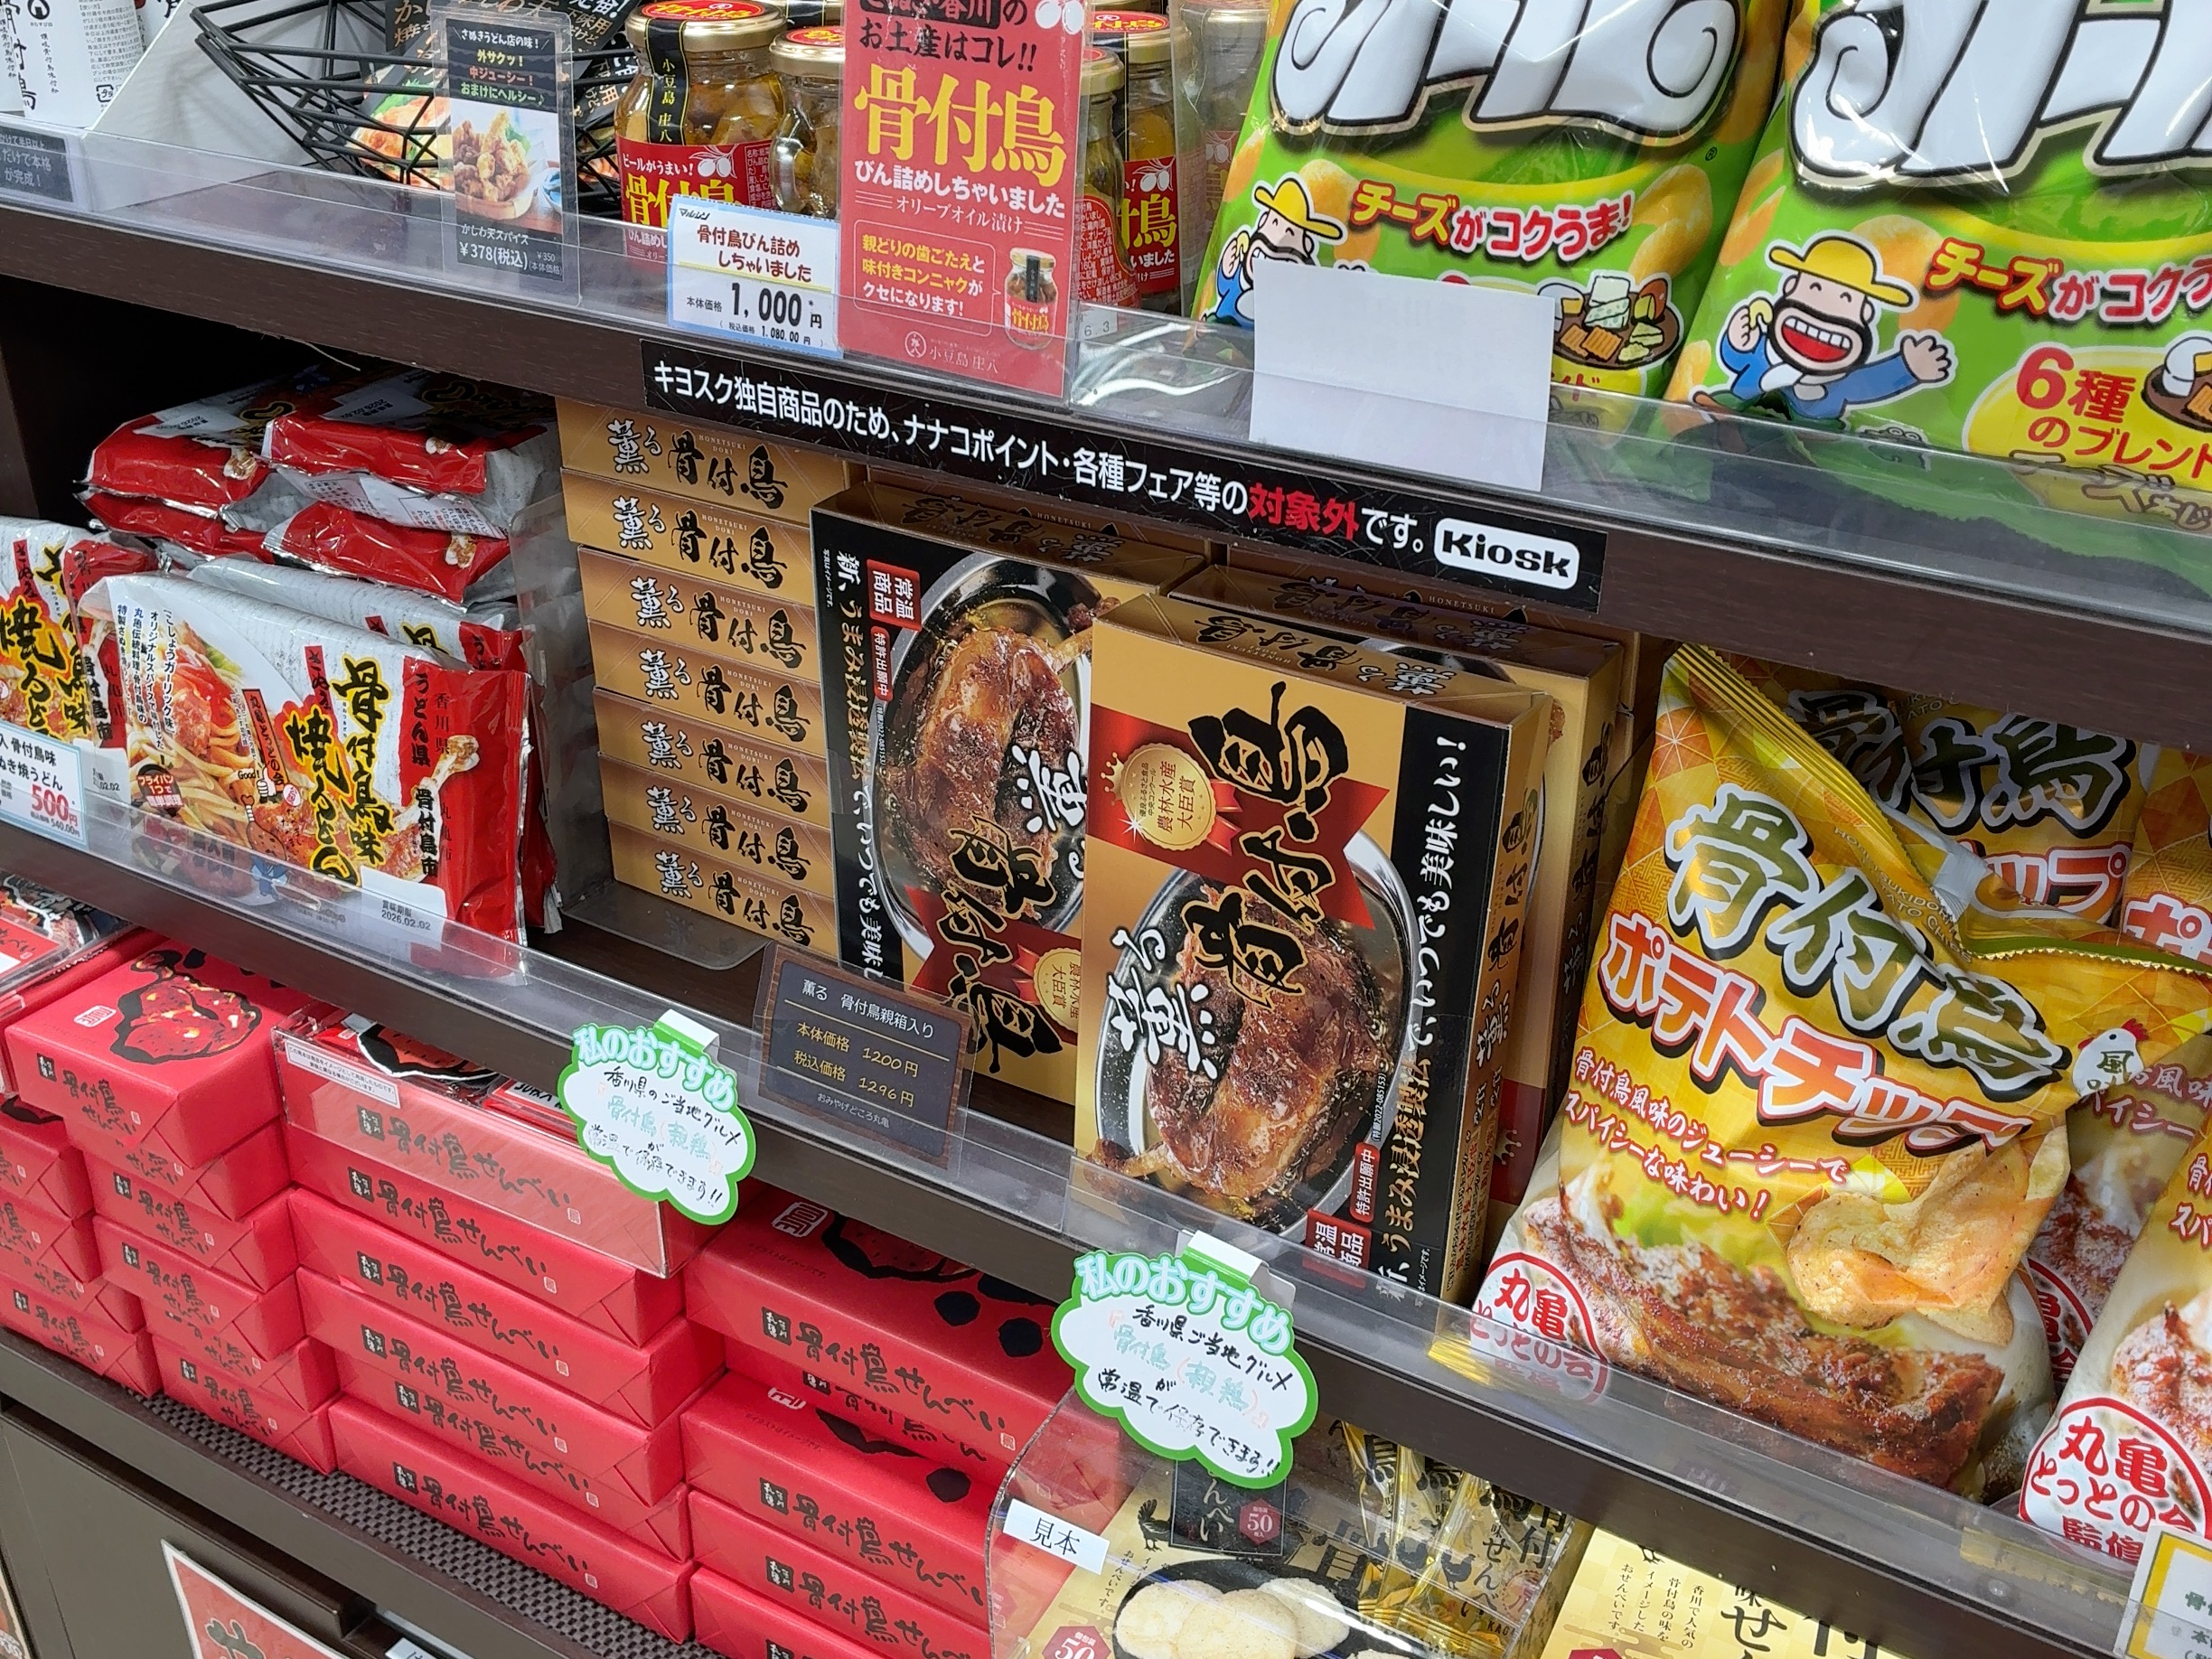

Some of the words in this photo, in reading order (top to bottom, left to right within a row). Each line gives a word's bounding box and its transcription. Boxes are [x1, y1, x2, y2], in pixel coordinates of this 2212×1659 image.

[469, 65, 534, 87] 中ジューシー!
[661, 58, 677, 106] 小豆島
[853, 62, 1068, 188] 骨付鳥
[622, 152, 694, 176] ビールがうまい!
[854, 159, 1066, 219] びん詰めしちゃいました
[697, 224, 801, 258] 骨付鳥びん詰め
[895, 195, 1023, 235] オリーブオイル漬け
[1350, 180, 1635, 261] チーズがコクうま!
[717, 250, 812, 283] しちゃいました
[861, 233, 986, 275] 親どりの歯ごたえと
[861, 258, 984, 297] 味付きコンニャクが
[686, 295, 723, 314] 本体価格
[809, 313, 822, 329] 円
[862, 280, 965, 318] クセになります!
[2016, 347, 2137, 424] 6種
[667, 429, 789, 510] 骨付鳥
[698, 434, 746, 452] HONETSUKI
[671, 509, 788, 589] 骨付鳥
[701, 513, 748, 532] HONETSUKI
[1441, 529, 1573, 579] Kiosk
[719, 595, 767, 614] HONETSUKI
[872, 569, 893, 614] 商品
[894, 577, 914, 622] 常温
[1428, 595, 1496, 616] HONETSUKI
[689, 590, 807, 670] 骨付鳥
[697, 664, 811, 743] 骨付鳥
[726, 669, 773, 689] HONETSUKI
[410, 670, 431, 767] うどん県
[11, 736, 57, 767] 骨付鳥味
[237, 769, 260, 781] Good!
[332, 655, 395, 866] 骨付鳥味
[698, 737, 812, 813] 骨付鳥
[727, 743, 773, 763] HONETSUKI
[731, 809, 775, 830] HONETSUKI
[1148, 767, 1157, 817] 中央コンクール
[1157, 760, 1176, 835] 農林水産
[1176, 775, 1196, 832] 大臣賞
[414, 787, 439, 877] 骨付鳥市
[701, 804, 811, 882] 骨付鳥
[1180, 680, 1350, 1010] 骨付鳥
[708, 870, 815, 947] 骨付鳥
[737, 875, 781, 897] HONETSUKI
[380, 909, 432, 931] 2026.02.02
[1668, 788, 2070, 1093] 骨付鳥
[796, 1022, 851, 1054] 本体価格
[801, 979, 829, 1001] 薫る
[840, 993, 934, 1039] 骨付鳥親箱入り
[573, 1026, 736, 1111] 私のおすすめ
[793, 1049, 847, 1083] 税込価格
[1575, 1048, 1849, 1183] 骨付鳥風味のジューシーで
[1354, 1148, 1375, 1217] 特許出願中
[1565, 1092, 1770, 1220] スパイシーな味わい!
[1076, 1252, 1291, 1354] 私のおすすめ
[1494, 1268, 1569, 1342] 丸亀
[1132, 1305, 1294, 1392] 香川県ご当地グルメ
[2058, 1415, 2170, 1498] 丸亀
[1028, 1517, 1082, 1557] 見本
[1247, 1515, 1273, 1532] 50
[1607, 1561, 1634, 1638] おせんべいです。
[1633, 1570, 1655, 1634] イメージした
[1656, 1576, 1682, 1642] 骨付鳥の味を
[1681, 1583, 1706, 1649] 香川で人気の
